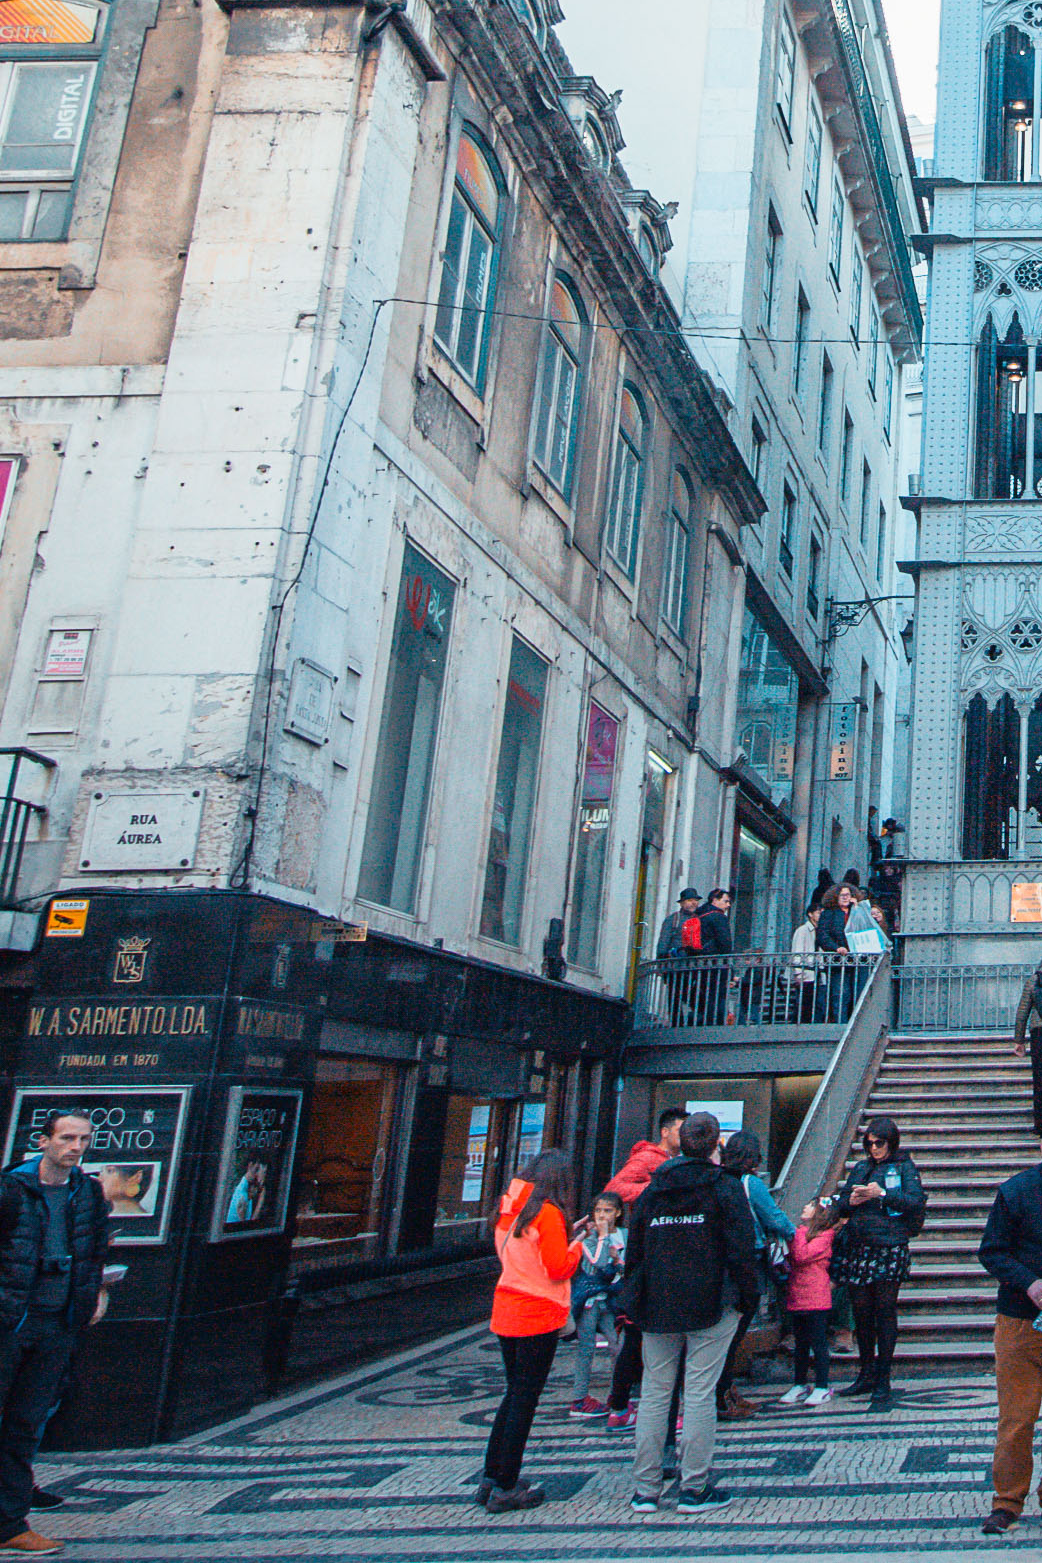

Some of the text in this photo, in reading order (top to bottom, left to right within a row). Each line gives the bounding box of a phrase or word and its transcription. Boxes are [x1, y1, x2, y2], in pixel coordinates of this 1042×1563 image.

[53, 74, 84, 140] DIGITAL
[838, 706, 849, 772] fotocine
[130, 815, 158, 824] RUA
[117, 830, 162, 844] ÁUREA
[168, 1005, 209, 1035] LDA.
[59, 1054, 159, 1067] FUNDADA EM 1870
[28, 1129, 155, 1150] SENTO
[650, 1214, 704, 1227] AERONES
